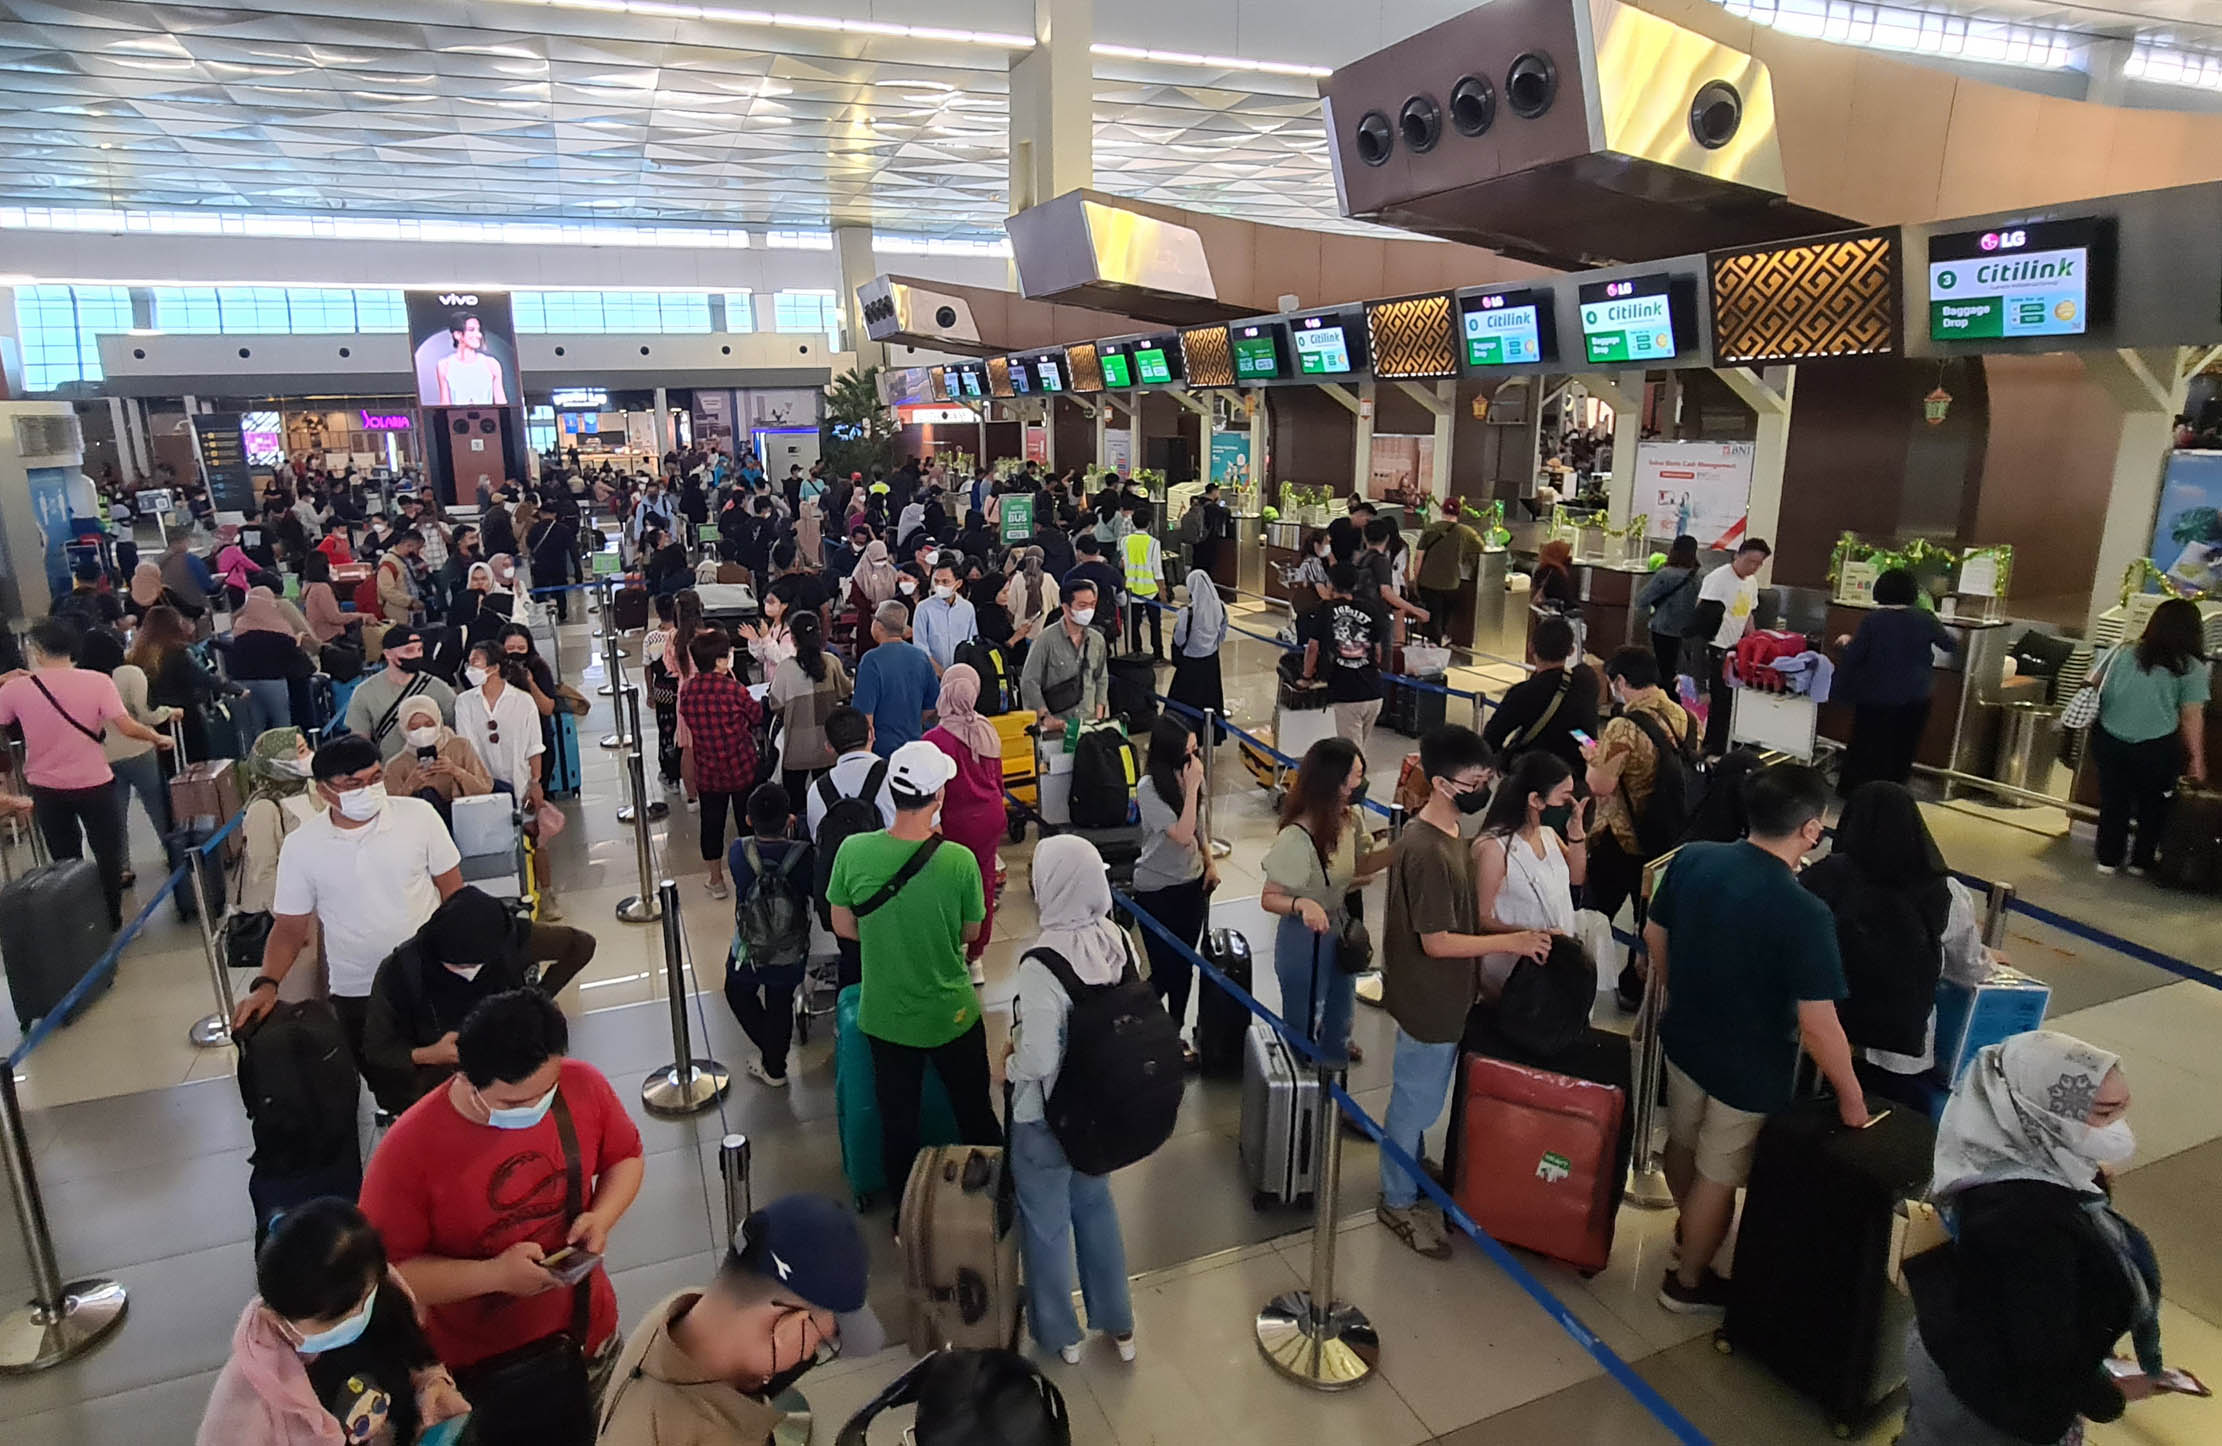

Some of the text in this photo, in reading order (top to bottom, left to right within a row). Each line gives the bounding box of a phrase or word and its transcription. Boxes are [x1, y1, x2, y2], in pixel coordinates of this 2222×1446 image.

[2001, 231, 2025, 248] LG
[1977, 258, 2075, 284] Citilink
[438, 293, 479, 306] vivo
[1608, 301, 1662, 321] Citilink
[1942, 306, 1991, 317] Baggage
[1487, 312, 1531, 328] Citilink
[1943, 318, 1969, 328] Drop
[1731, 446, 1751, 456] BNI
